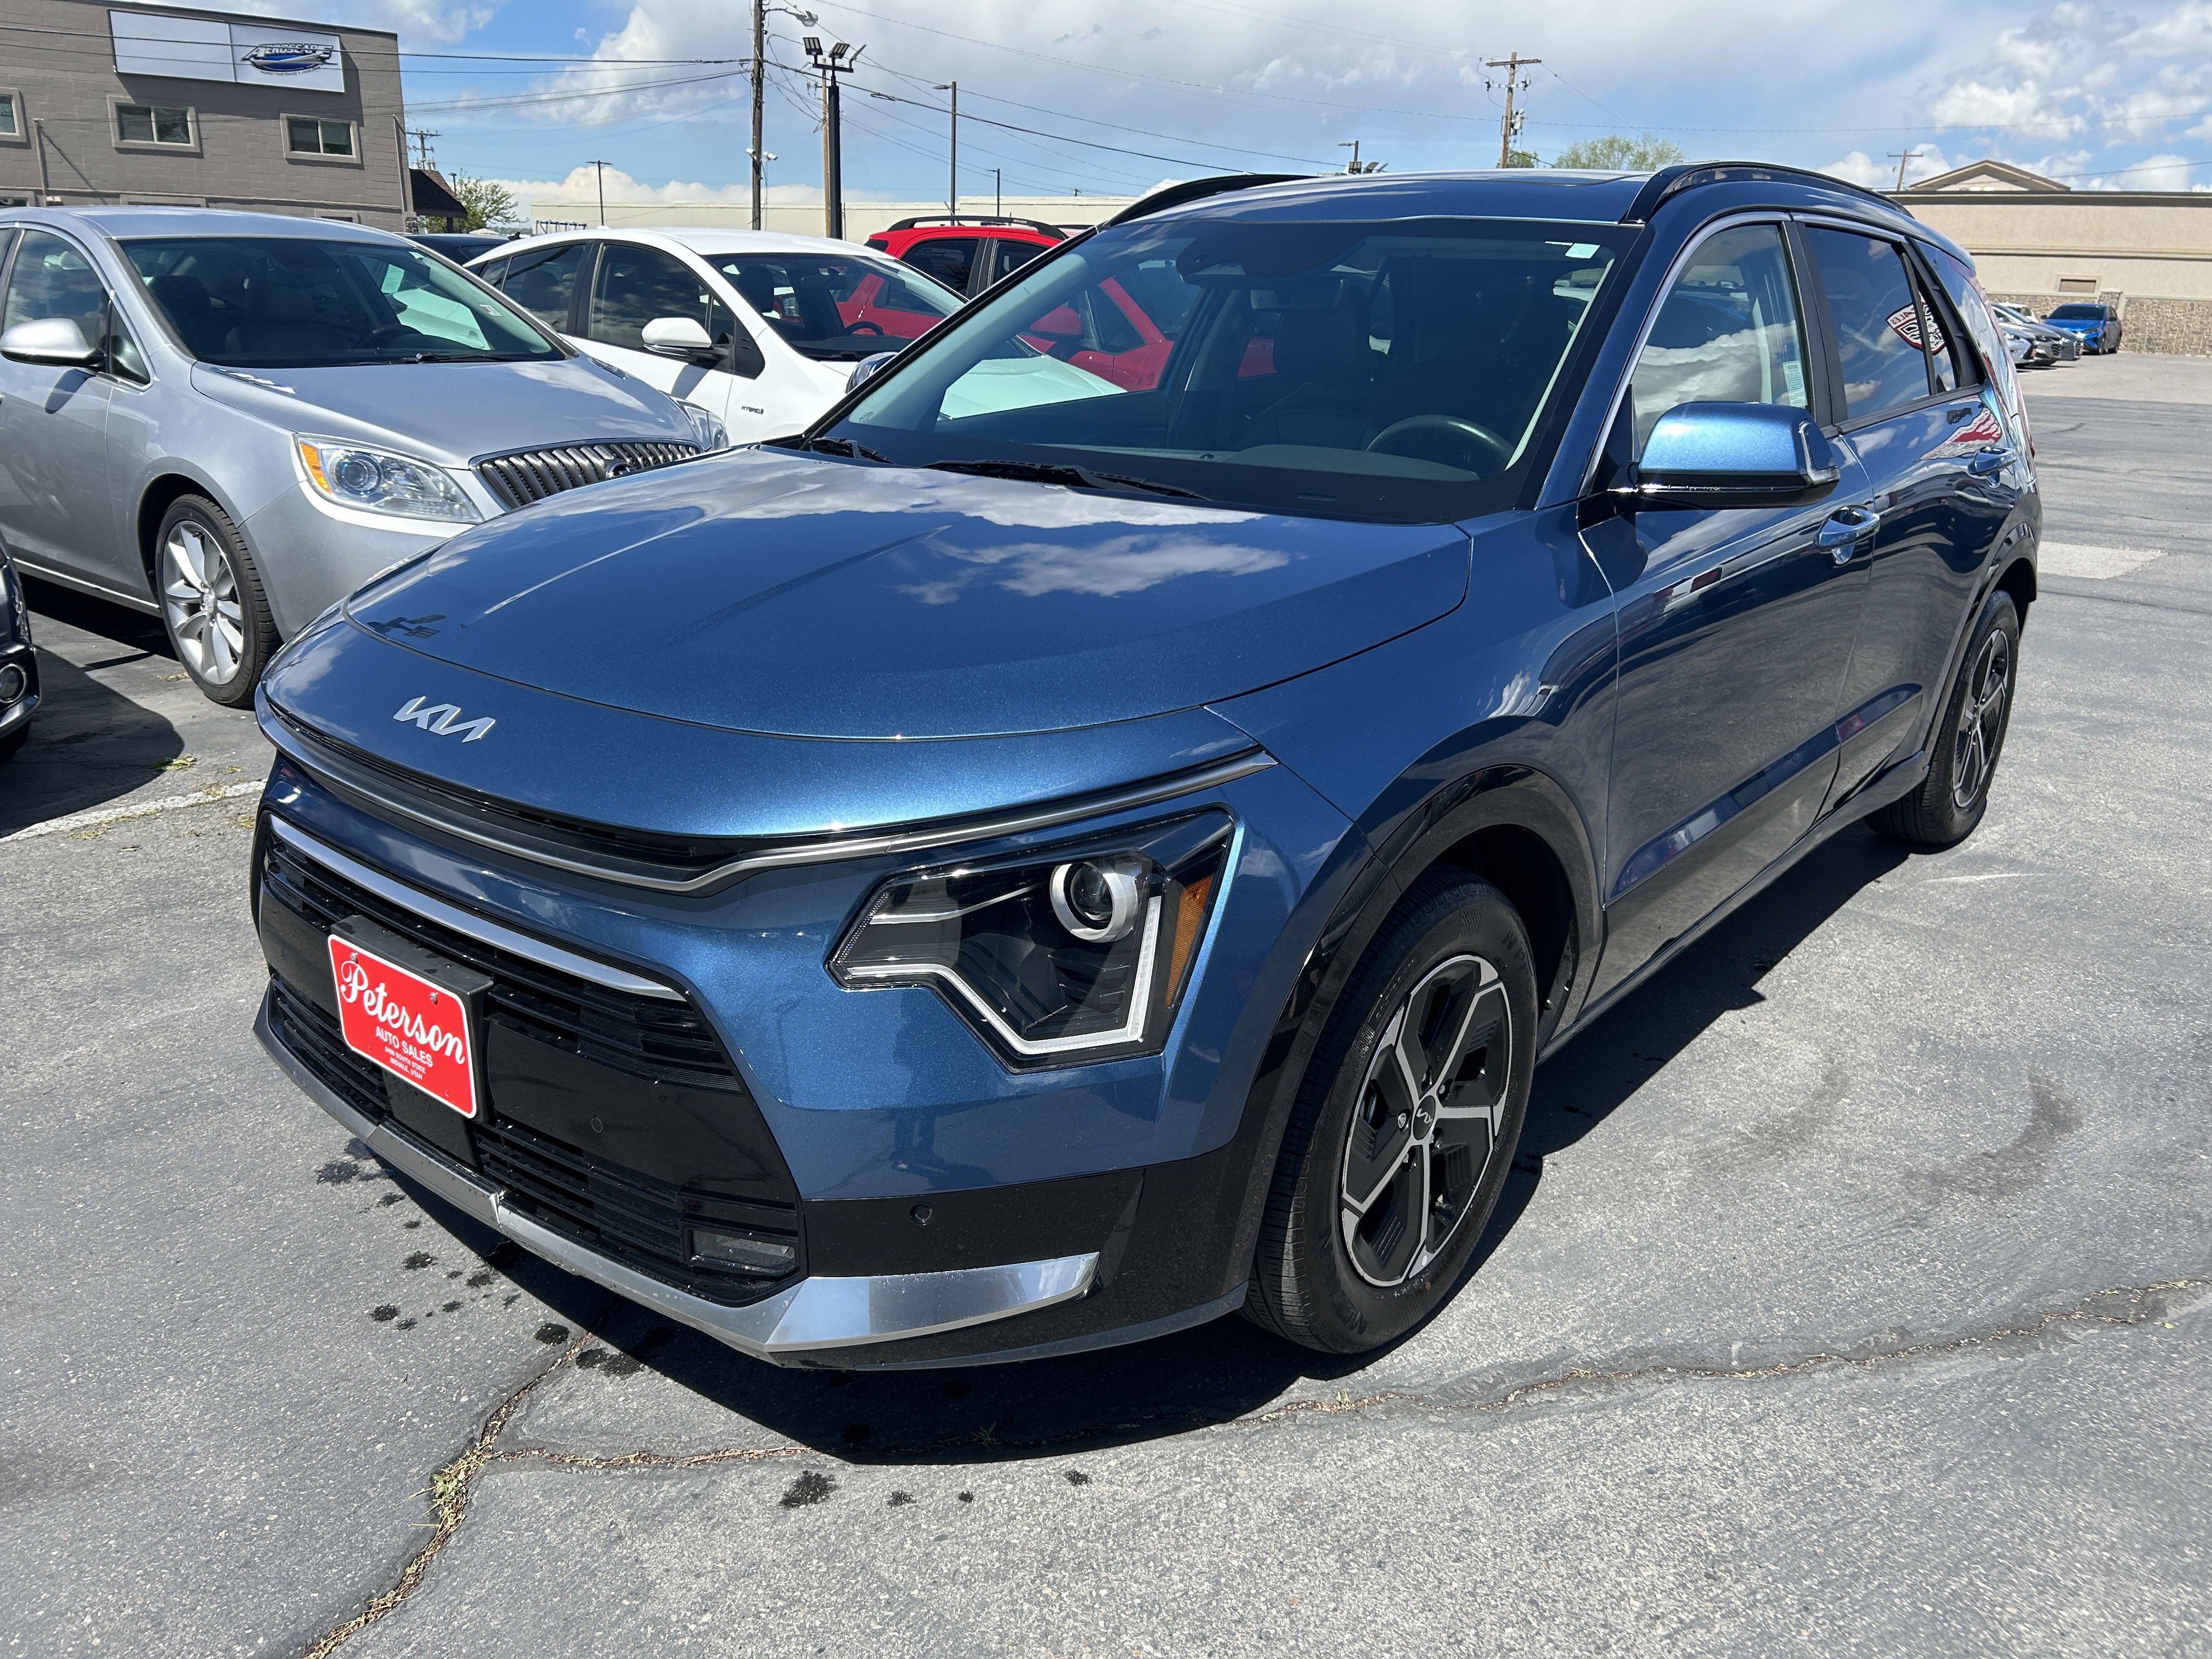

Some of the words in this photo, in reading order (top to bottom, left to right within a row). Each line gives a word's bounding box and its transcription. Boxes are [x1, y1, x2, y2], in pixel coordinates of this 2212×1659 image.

[240, 43, 334, 61] AEROSCAPE
[742, 405, 760, 414] HYBRID
[393, 696, 496, 743] KIA
[340, 961, 465, 1064] Peterson
[376, 1025, 399, 1049] AUTO
[402, 1040, 433, 1068] SALES
[395, 1052, 411, 1066] SOUTH
[411, 1060, 426, 1075] STATE
[410, 1068, 423, 1081] UTAH
